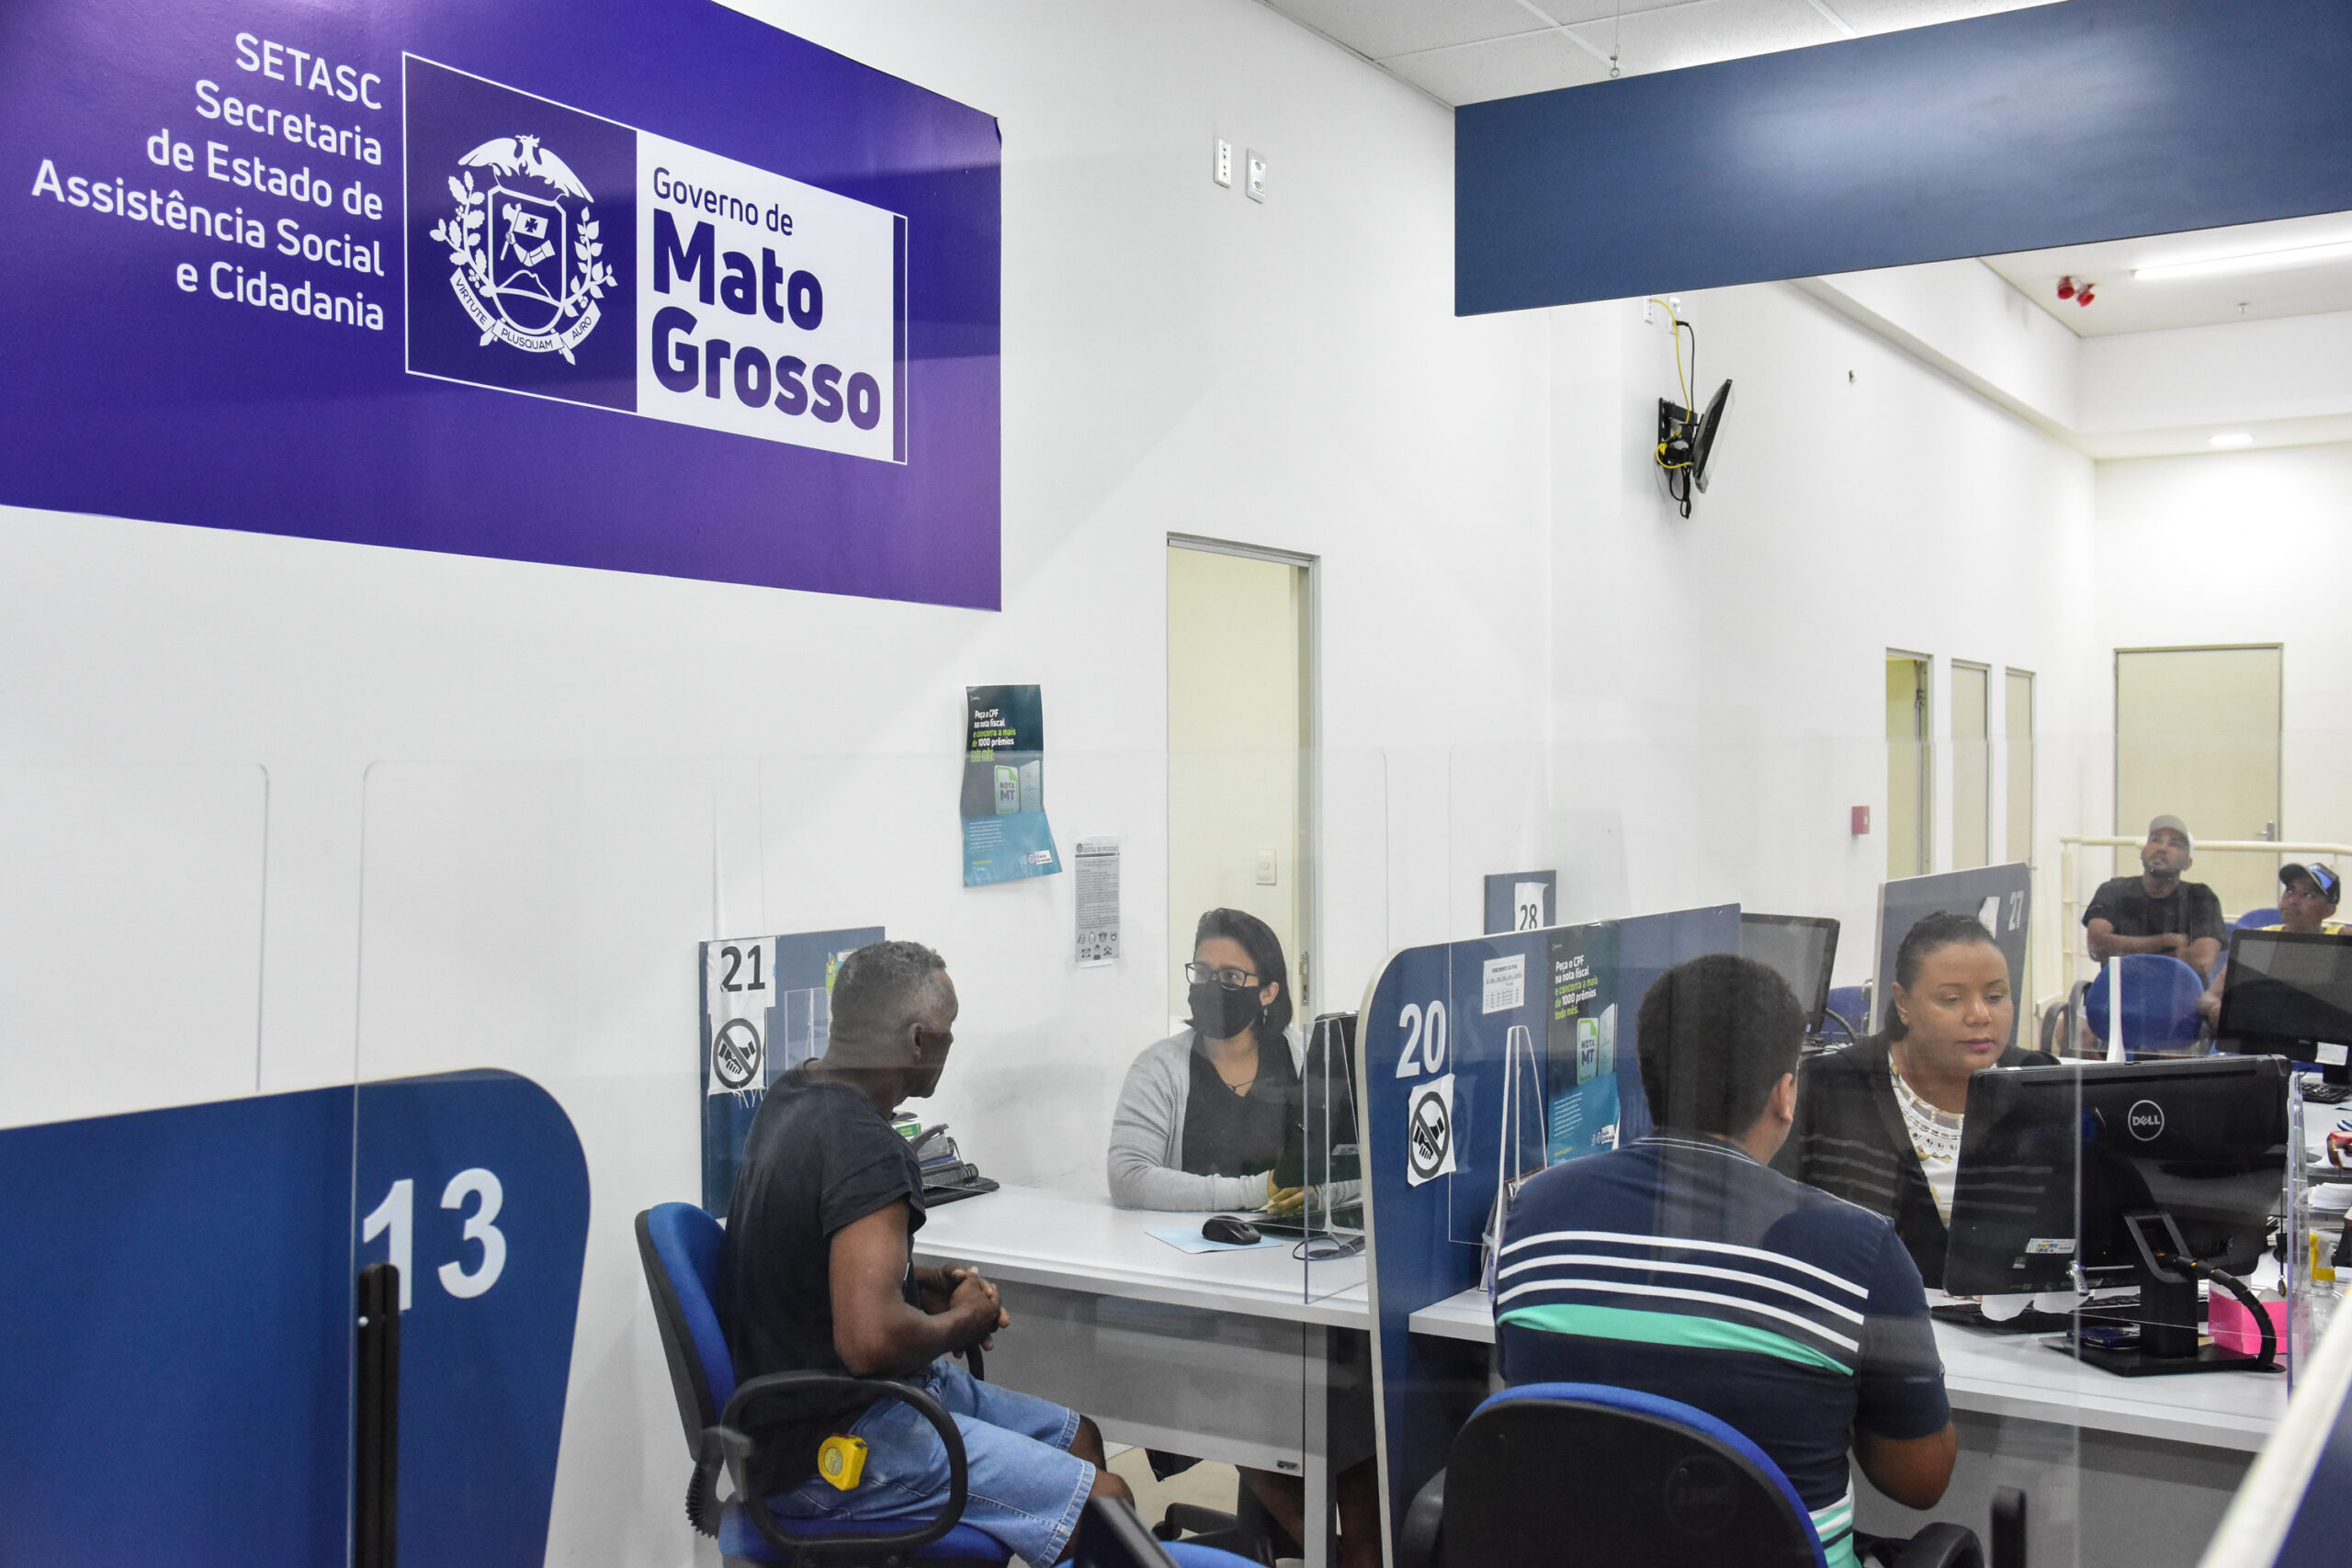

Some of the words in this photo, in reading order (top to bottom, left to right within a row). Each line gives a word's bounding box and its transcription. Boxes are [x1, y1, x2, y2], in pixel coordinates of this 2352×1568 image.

[236, 33, 381, 109] SETASC
[196, 80, 381, 164] Secretaria
[148, 129, 194, 171] de
[208, 141, 332, 207] Estado
[343, 181, 382, 220] de
[32, 159, 265, 248] Assistência
[277, 219, 384, 276] Social
[654, 167, 758, 226] Governo
[766, 204, 792, 236] de
[654, 209, 822, 330] Mato
[177, 264, 198, 291] e
[210, 262, 383, 330] Cidadania
[456, 277, 487, 325] VIRTUTE
[501, 328, 553, 350] PLUSQUAM
[571, 316, 592, 340] AURO
[652, 307, 880, 430] Grosso
[989, 709, 999, 717] CPF
[989, 718, 1005, 727] fiscal
[978, 738, 990, 747] 1000
[991, 737, 1014, 748] prêmios
[1000, 790, 1015, 801] MT
[1521, 903, 1537, 931] 28
[2008, 890, 2024, 931] 27
[721, 945, 765, 992] 21
[1555, 961, 1567, 973] Peça
[1574, 955, 1584, 967] CPF
[1555, 976, 1561, 984] na
[1562, 971, 1575, 982] nota
[1575, 965, 1589, 978] fiscal
[1555, 998, 1561, 1008] de
[1562, 993, 1575, 1006] 1000
[1576, 987, 1597, 1004] prêmios
[1559, 982, 1582, 995] concorra
[1555, 1008, 1566, 1021] todo
[1396, 1000, 1446, 1078] 20
[1581, 1039, 1595, 1049] NOTA
[1581, 1049, 1595, 1066] MT
[2132, 1115, 2161, 1126] DELL
[364, 1168, 506, 1312] 13
